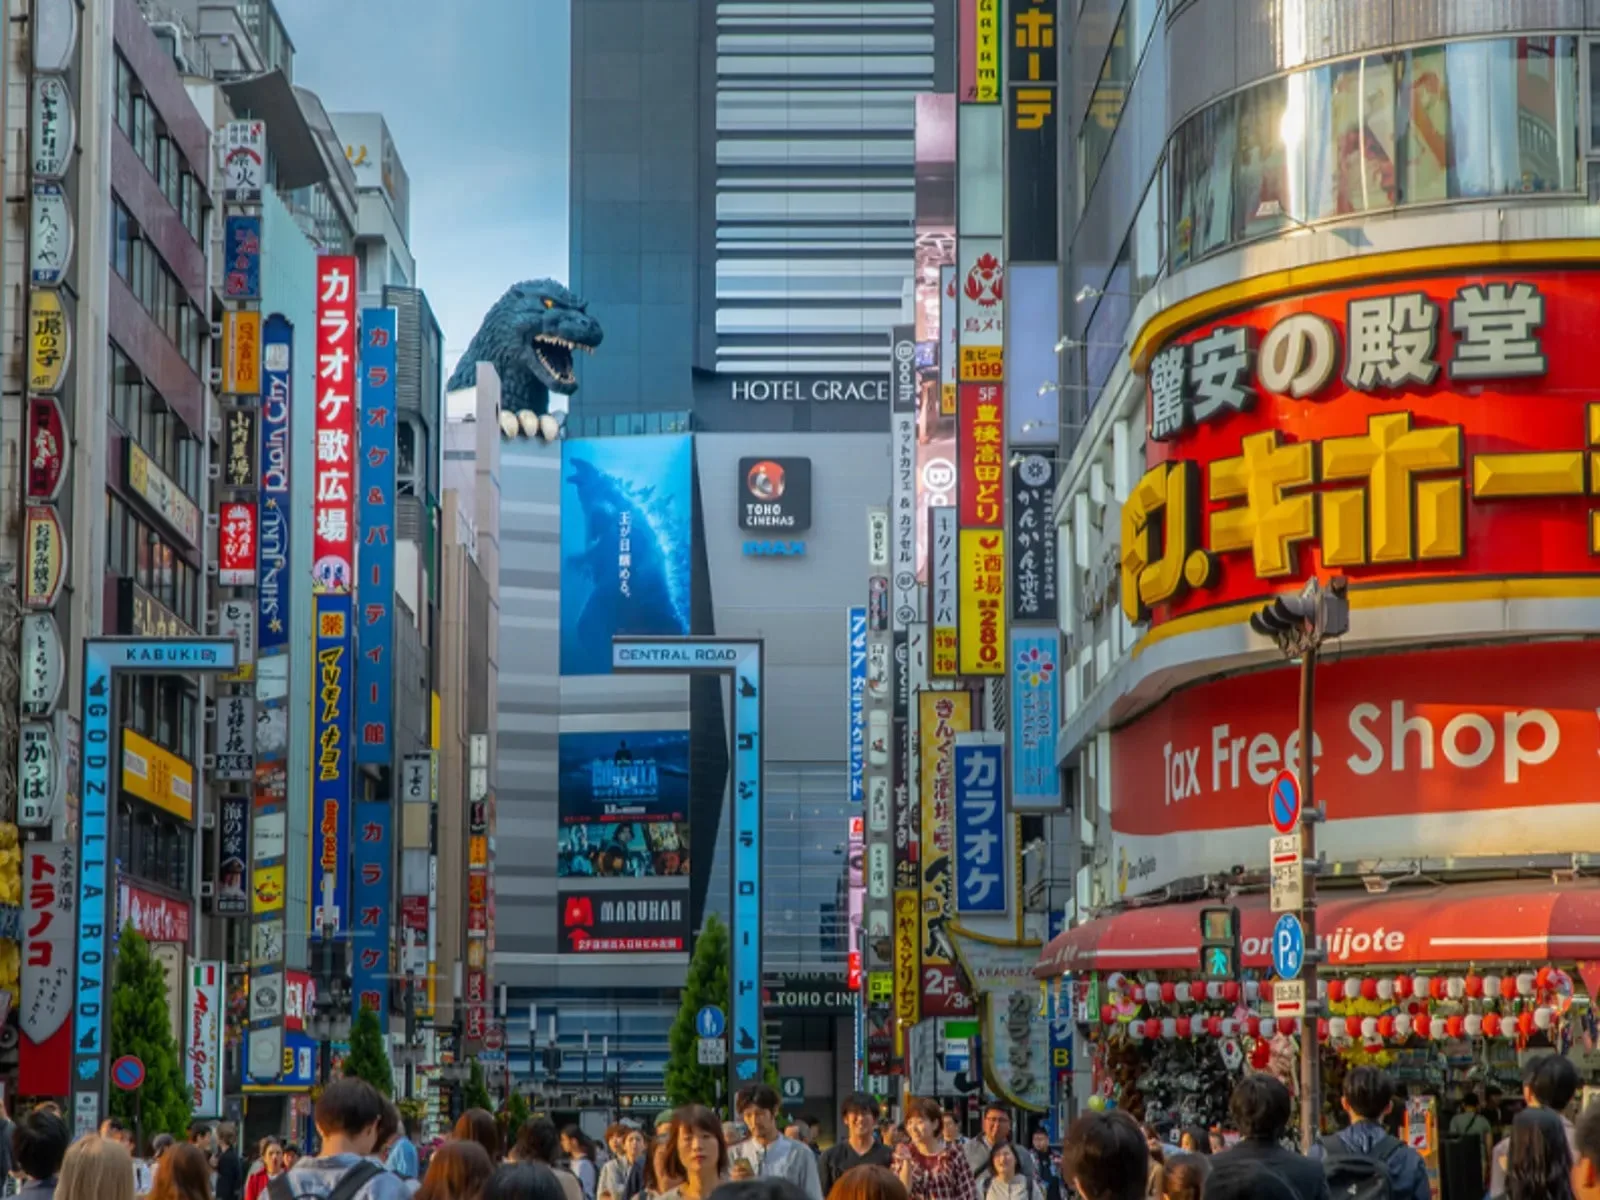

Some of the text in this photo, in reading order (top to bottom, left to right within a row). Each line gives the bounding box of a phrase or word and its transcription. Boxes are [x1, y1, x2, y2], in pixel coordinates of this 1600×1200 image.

[1015, 0, 1053, 128] ホーテ
[35, 317, 62, 367] 虎の子
[1149, 282, 1544, 440] 驚安の殿堂
[262, 373, 288, 423] City
[318, 267, 350, 543] カラオケ歌広場
[731, 380, 889, 401] HOTEL GRACE
[899, 420, 914, 492] ネットカフェ
[746, 503, 780, 516] TOHO
[746, 516, 795, 527] CINEMAS
[34, 523, 50, 595] お好み焼き
[260, 512, 286, 615] SHINJUKU
[743, 540, 806, 557] IMAX
[321, 613, 344, 636] 薬
[979, 610, 999, 662] 280
[618, 648, 738, 661] CENTRAL ROAD
[318, 646, 345, 781] マツモトキヨシ
[1162, 700, 1561, 806] Tax Free Shop
[960, 750, 1000, 906] カラオケ
[80, 703, 107, 1018] GODZILLA ROAD
[738, 732, 758, 997] ゴジラロード
[28, 854, 56, 968] トラノコ
[600, 900, 683, 923] MARUHAN
[1316, 927, 1405, 960] uijote
[776, 991, 859, 1006] TOHO CIN
[925, 967, 956, 996] 2F
